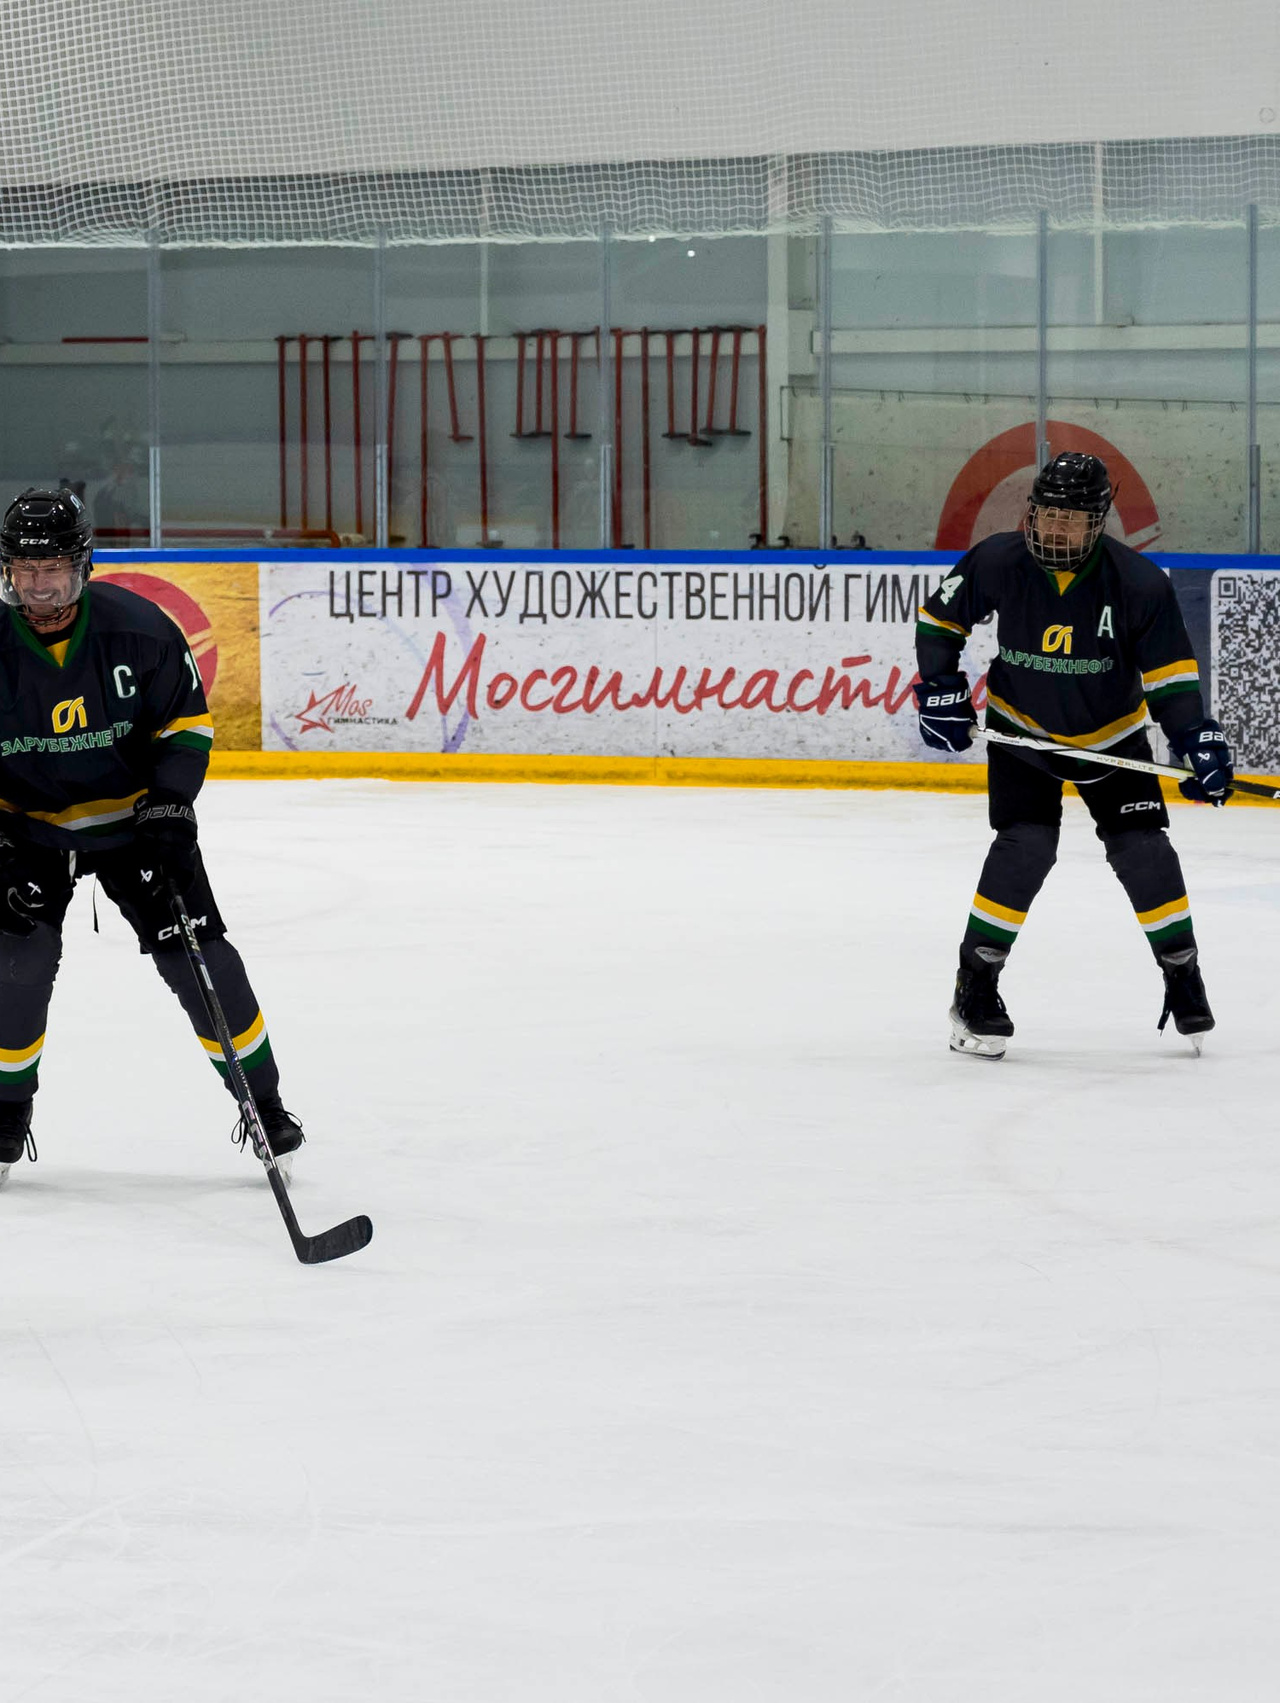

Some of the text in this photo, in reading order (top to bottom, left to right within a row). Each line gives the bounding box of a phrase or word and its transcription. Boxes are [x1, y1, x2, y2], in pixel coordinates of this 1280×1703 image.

[329, 570, 452, 624] ЦЕНТР
[465, 564, 830, 624] ХУДОЖЕСТВЕННОЙ
[1097, 605, 1115, 639] A
[113, 665, 136, 699] C
[406, 631, 987, 720] Мосгимнасти
[1, 720, 133, 756] ЗАРУБЕЖНЕТЬ
[1120, 802, 1161, 814] CCM
